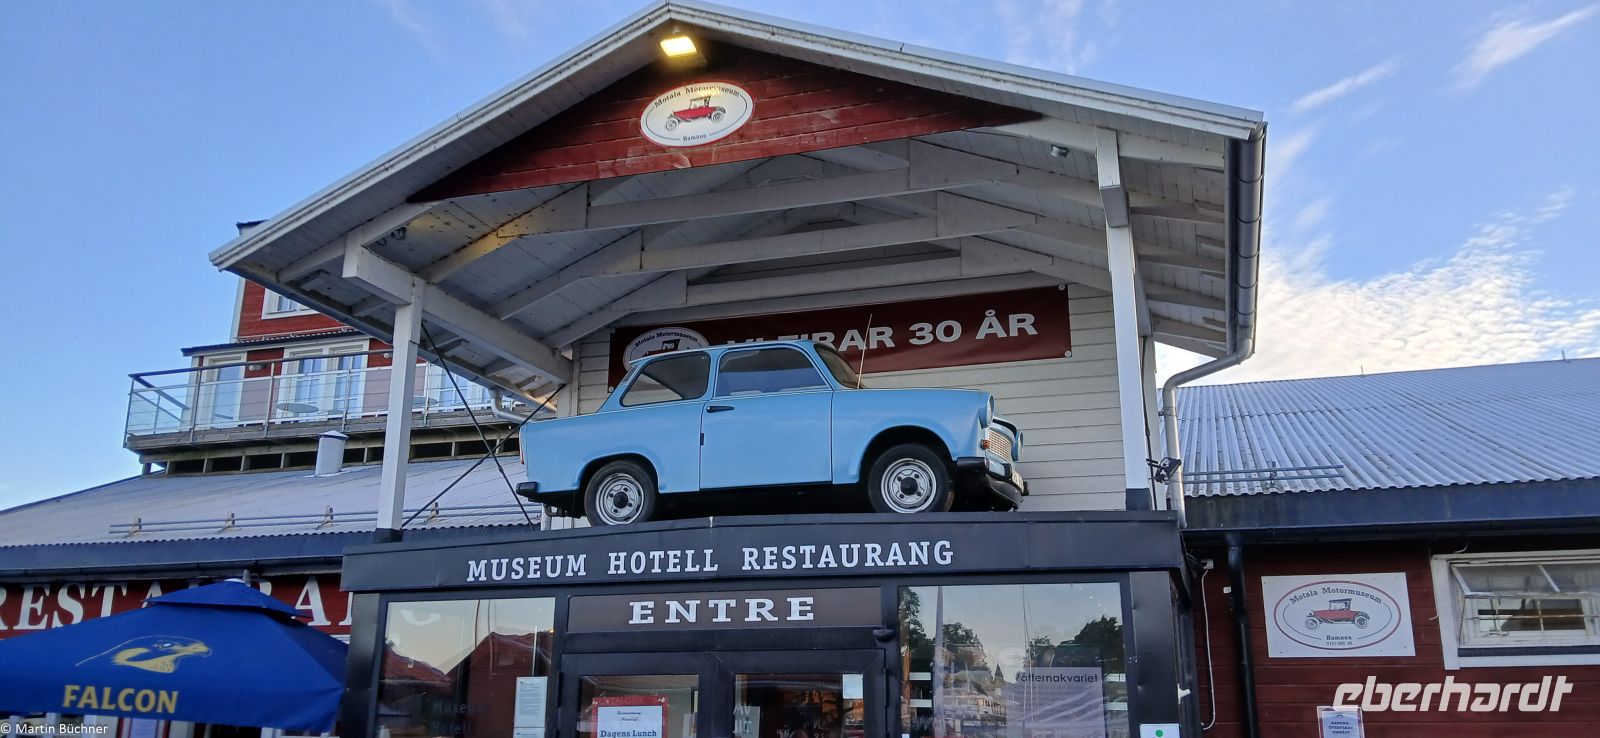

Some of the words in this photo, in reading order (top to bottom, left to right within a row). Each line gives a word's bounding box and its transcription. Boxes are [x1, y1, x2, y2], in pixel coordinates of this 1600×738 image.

[653, 91, 682, 108] Motala
[909, 319, 963, 345] 30
[976, 309, 1039, 341] ÅR
[466, 553, 588, 583] MUSEUM
[608, 547, 719, 575] HOTELL
[741, 539, 955, 571] RESTAURANG
[628, 596, 815, 625] ENTRE
[1289, 590, 1319, 605] Motala
[1321, 587, 1383, 604] Motormuseum
[62, 684, 179, 714] FALCON
[600, 730, 631, 738] Dagens
[632, 729, 657, 737] Lunch
